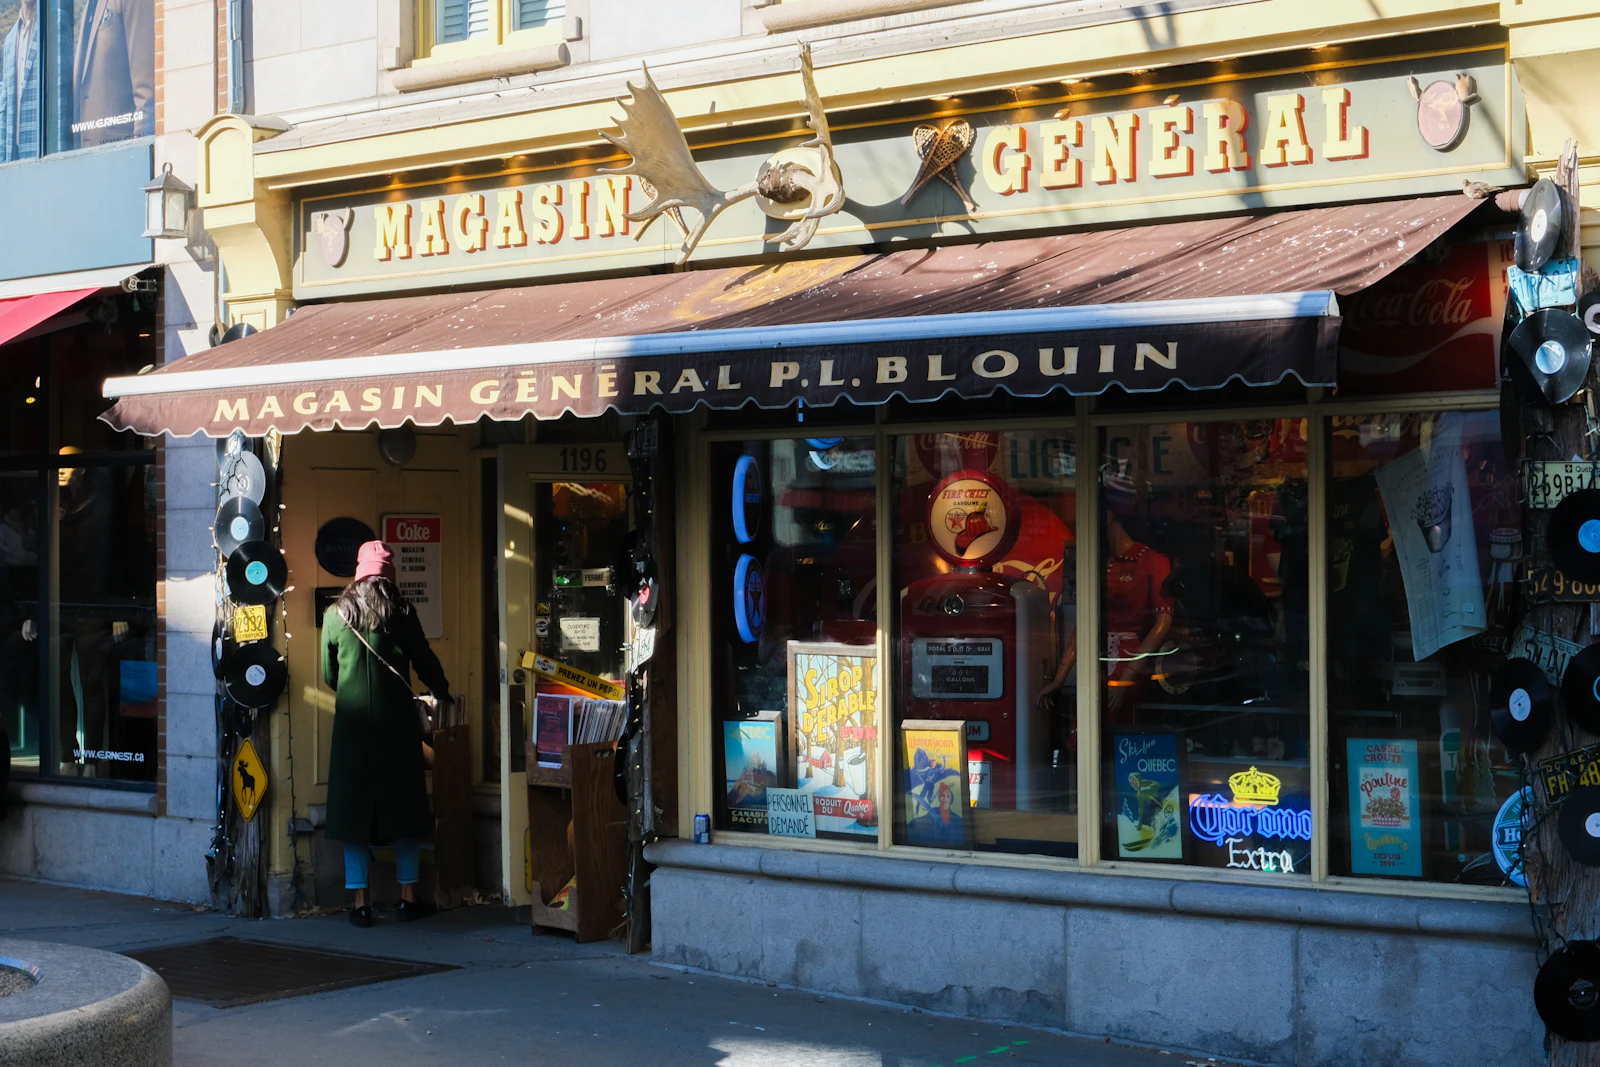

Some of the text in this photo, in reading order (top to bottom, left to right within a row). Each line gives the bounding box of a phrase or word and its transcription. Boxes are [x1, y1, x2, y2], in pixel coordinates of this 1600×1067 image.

[373, 87, 1369, 261] MAGASIN GÉNÉRAL
[1345, 276, 1477, 332] Coca-Cola
[213, 383, 443, 422] MAGASIN
[560, 447, 607, 472] 1196
[396, 521, 431, 541] Coke
[584, 571, 604, 582] FERMÉ
[557, 667, 620, 698] PRENEZ UN PEPSI
[805, 665, 863, 710] SIROP
[841, 725, 877, 741] PUR
[1366, 743, 1400, 754] CASSE
[767, 793, 813, 814] PERSONNEL
[814, 797, 842, 807] RODUIT
[821, 806, 833, 815] DU
[731, 810, 768, 819] CANADIA
[731, 816, 768, 825] PACIFI
[770, 814, 810, 836] DEMANDÉ
[1188, 793, 1313, 847] Corona
[1224, 838, 1295, 873] Extra
[1373, 852, 1401, 860] DEPUIS
